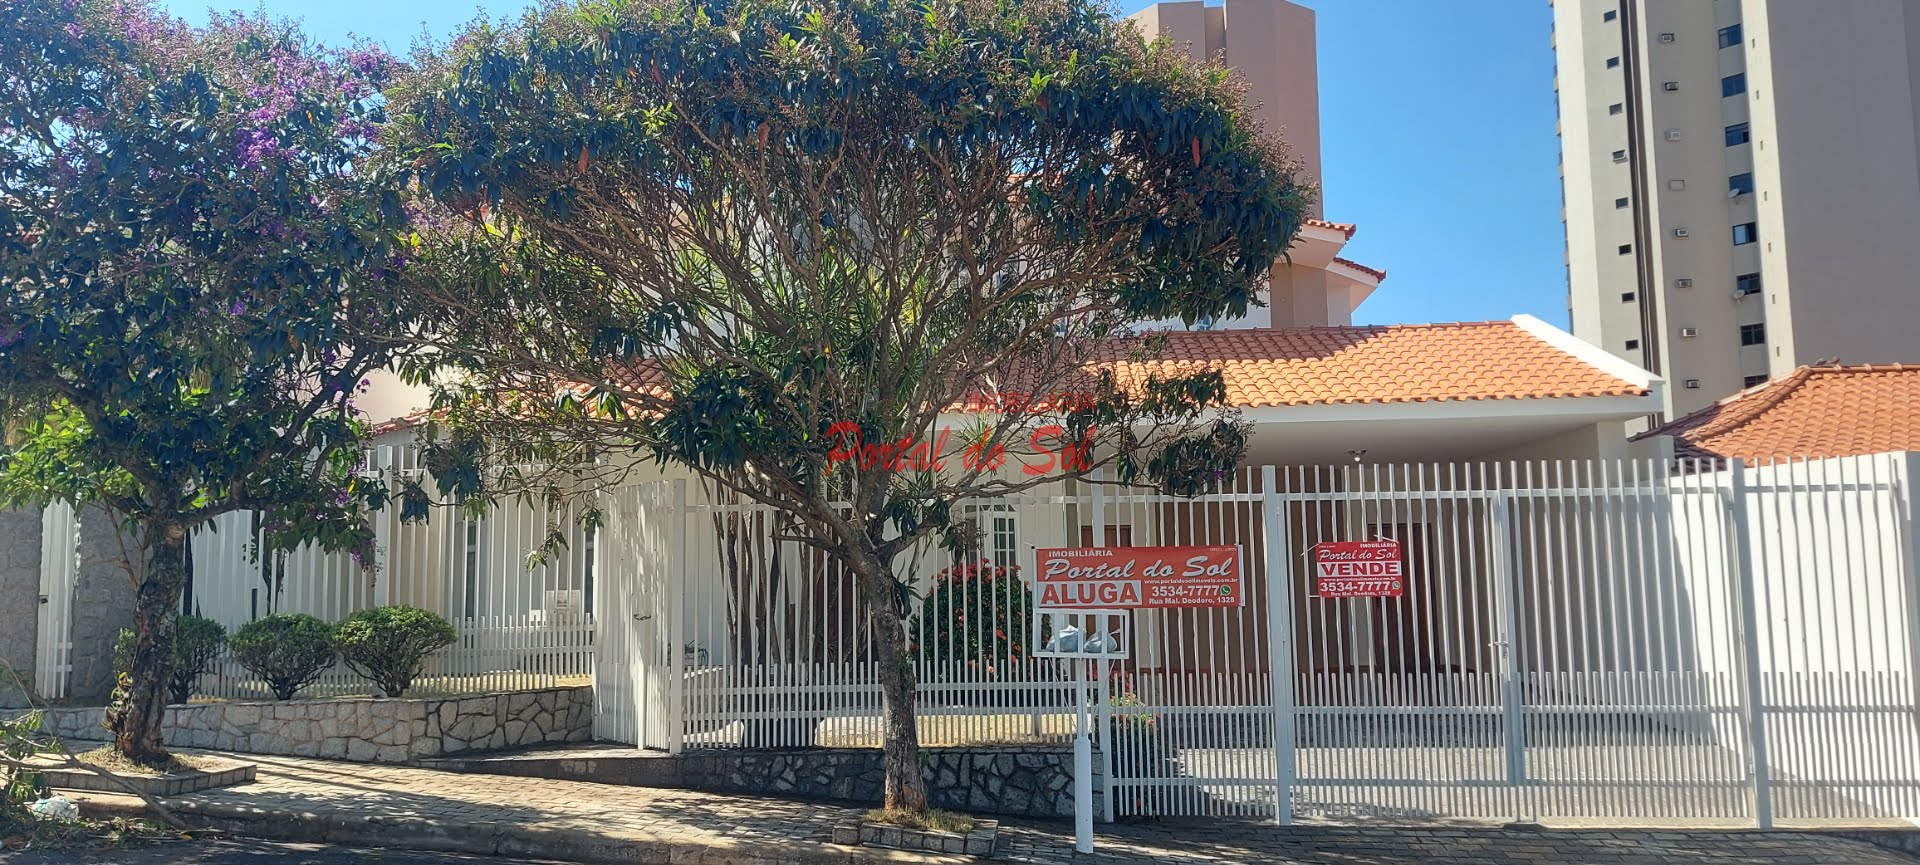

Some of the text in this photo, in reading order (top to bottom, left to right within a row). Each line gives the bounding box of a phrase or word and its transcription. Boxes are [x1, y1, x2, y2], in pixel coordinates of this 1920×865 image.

[1048, 549, 1113, 557] IMOBILIÁRIA
[1319, 549, 1397, 561] Portal do Sol
[1044, 555, 1233, 580] Portal do Sol
[1321, 562, 1398, 576] VENDE
[1152, 585, 1219, 597] 3534-7777
[1320, 581, 1391, 592] 3534-7777
[1041, 582, 1138, 604] ALUGA
[1182, 597, 1215, 605] Deodoro,
